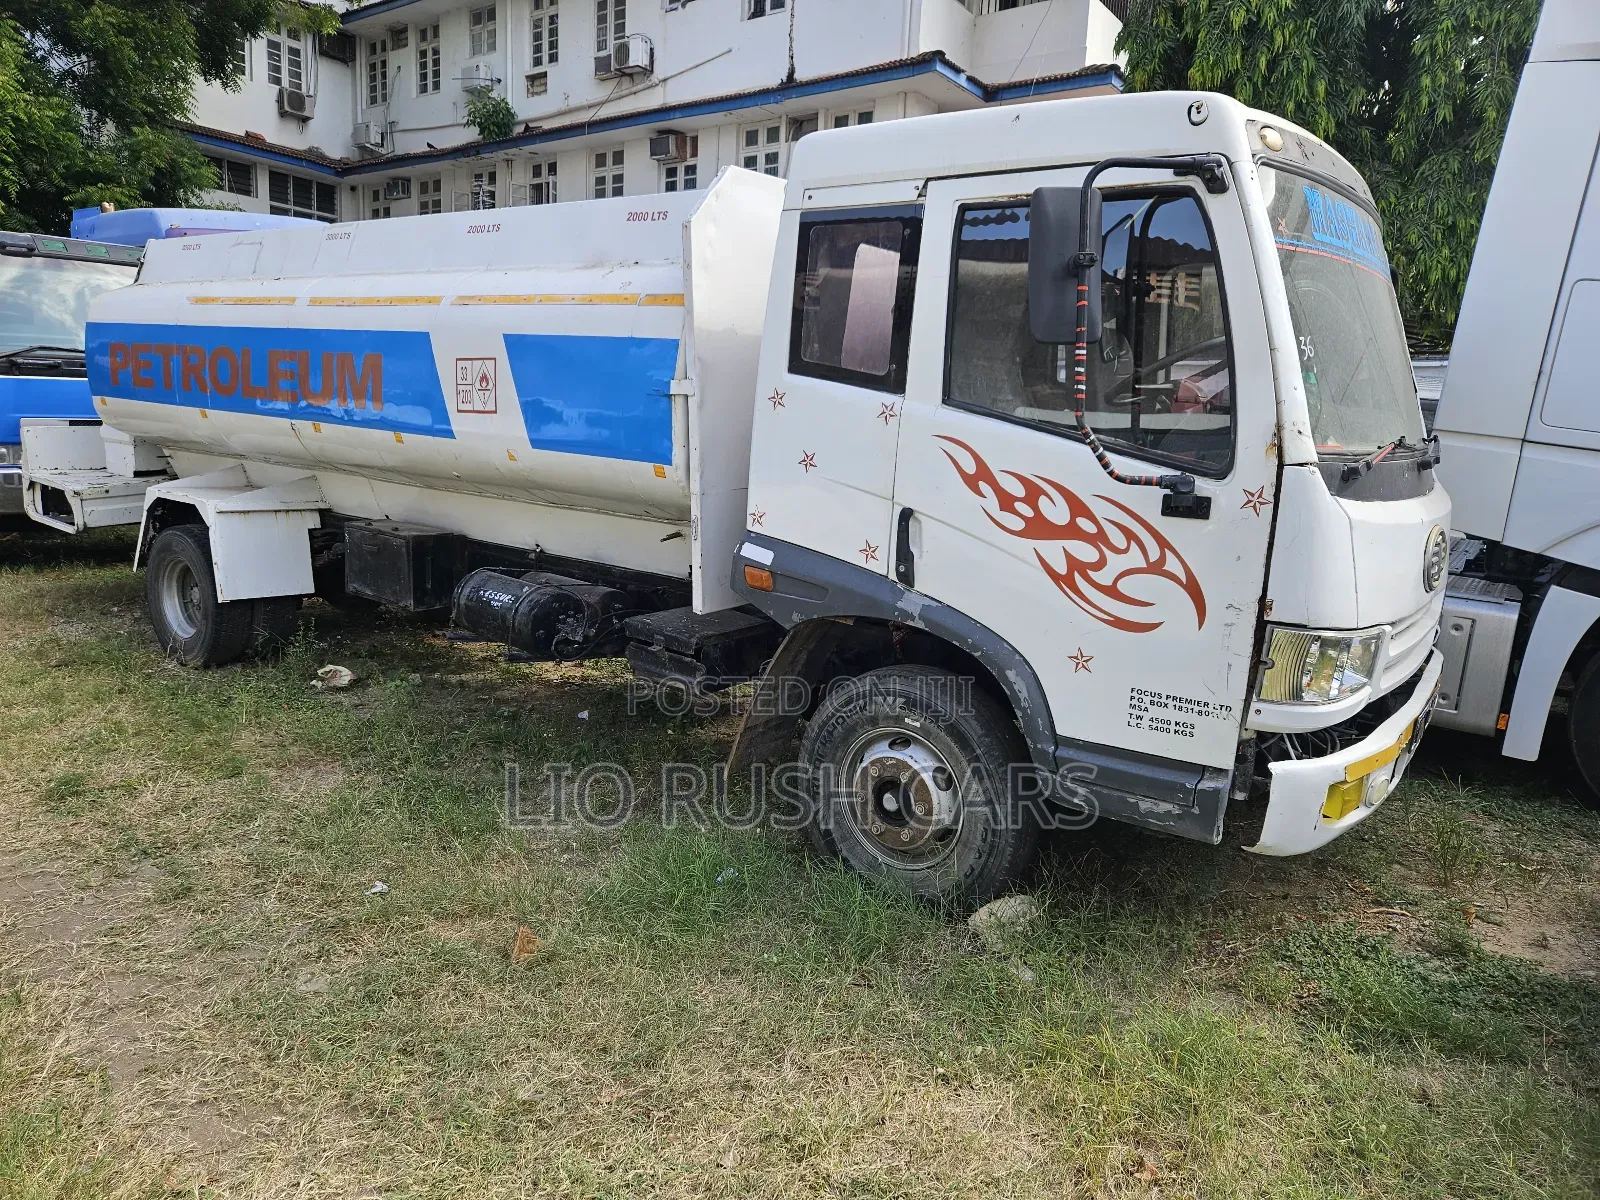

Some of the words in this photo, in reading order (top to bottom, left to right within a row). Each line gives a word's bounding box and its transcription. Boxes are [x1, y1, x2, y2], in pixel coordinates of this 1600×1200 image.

[626, 211, 649, 222] 2000
[650, 210, 669, 221] LTS
[339, 231, 352, 240] LTS
[467, 224, 486, 234] 2000
[486, 223, 501, 233] LTS
[1299, 336, 1315, 360] 36
[108, 341, 384, 411] PETROLEUM
[460, 365, 468, 381] 33
[458, 389, 472, 404] 1203
[1130, 687, 1163, 700] FOCUS
[1165, 694, 1210, 709] PREMIER
[1212, 703, 1232, 713] LTD
[1149, 700, 1169, 709] BOX
[1128, 703, 1149, 713] MSA
[1127, 720, 1145, 730] L.C.
[1148, 724, 1171, 734] 5400
[1173, 728, 1195, 738] KGS
[1148, 716, 1172, 726] 4500
[1174, 720, 1195, 730] KGS
